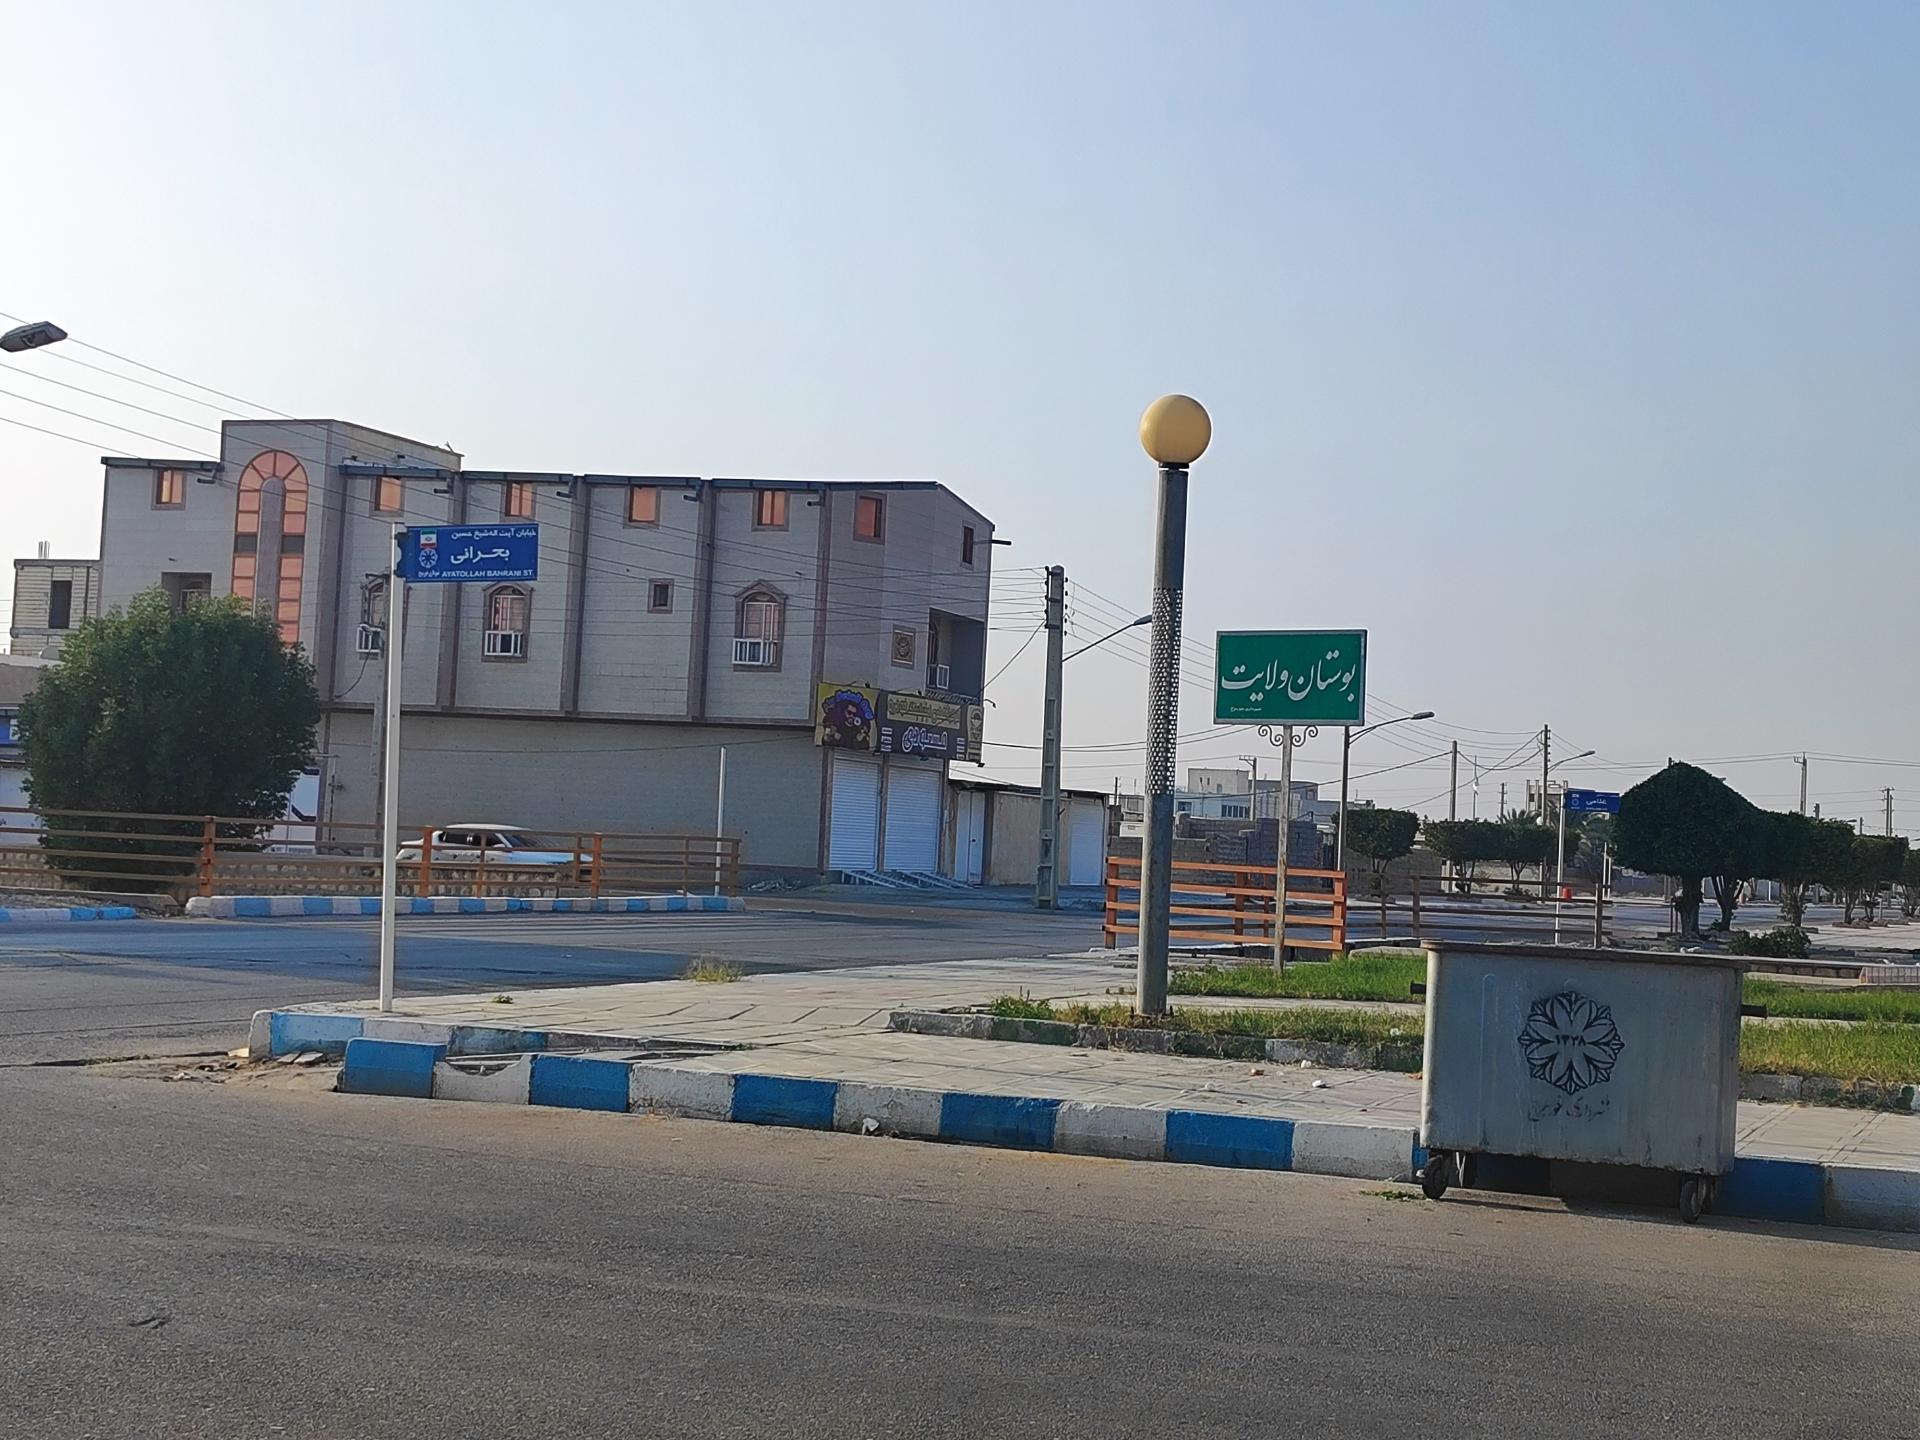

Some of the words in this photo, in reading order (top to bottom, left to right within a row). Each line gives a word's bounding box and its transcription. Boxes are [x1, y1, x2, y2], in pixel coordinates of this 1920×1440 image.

[451, 529, 473, 540] حسین
[499, 527, 515, 538] آیت
[515, 528, 537, 538] خیابان
[450, 545, 510, 564] بحرانی
[441, 570, 486, 578] AYATOLLAH
[486, 569, 522, 577] BAHRANI
[1221, 658, 1289, 702] ولایت
[1287, 649, 1356, 702] بوستان
